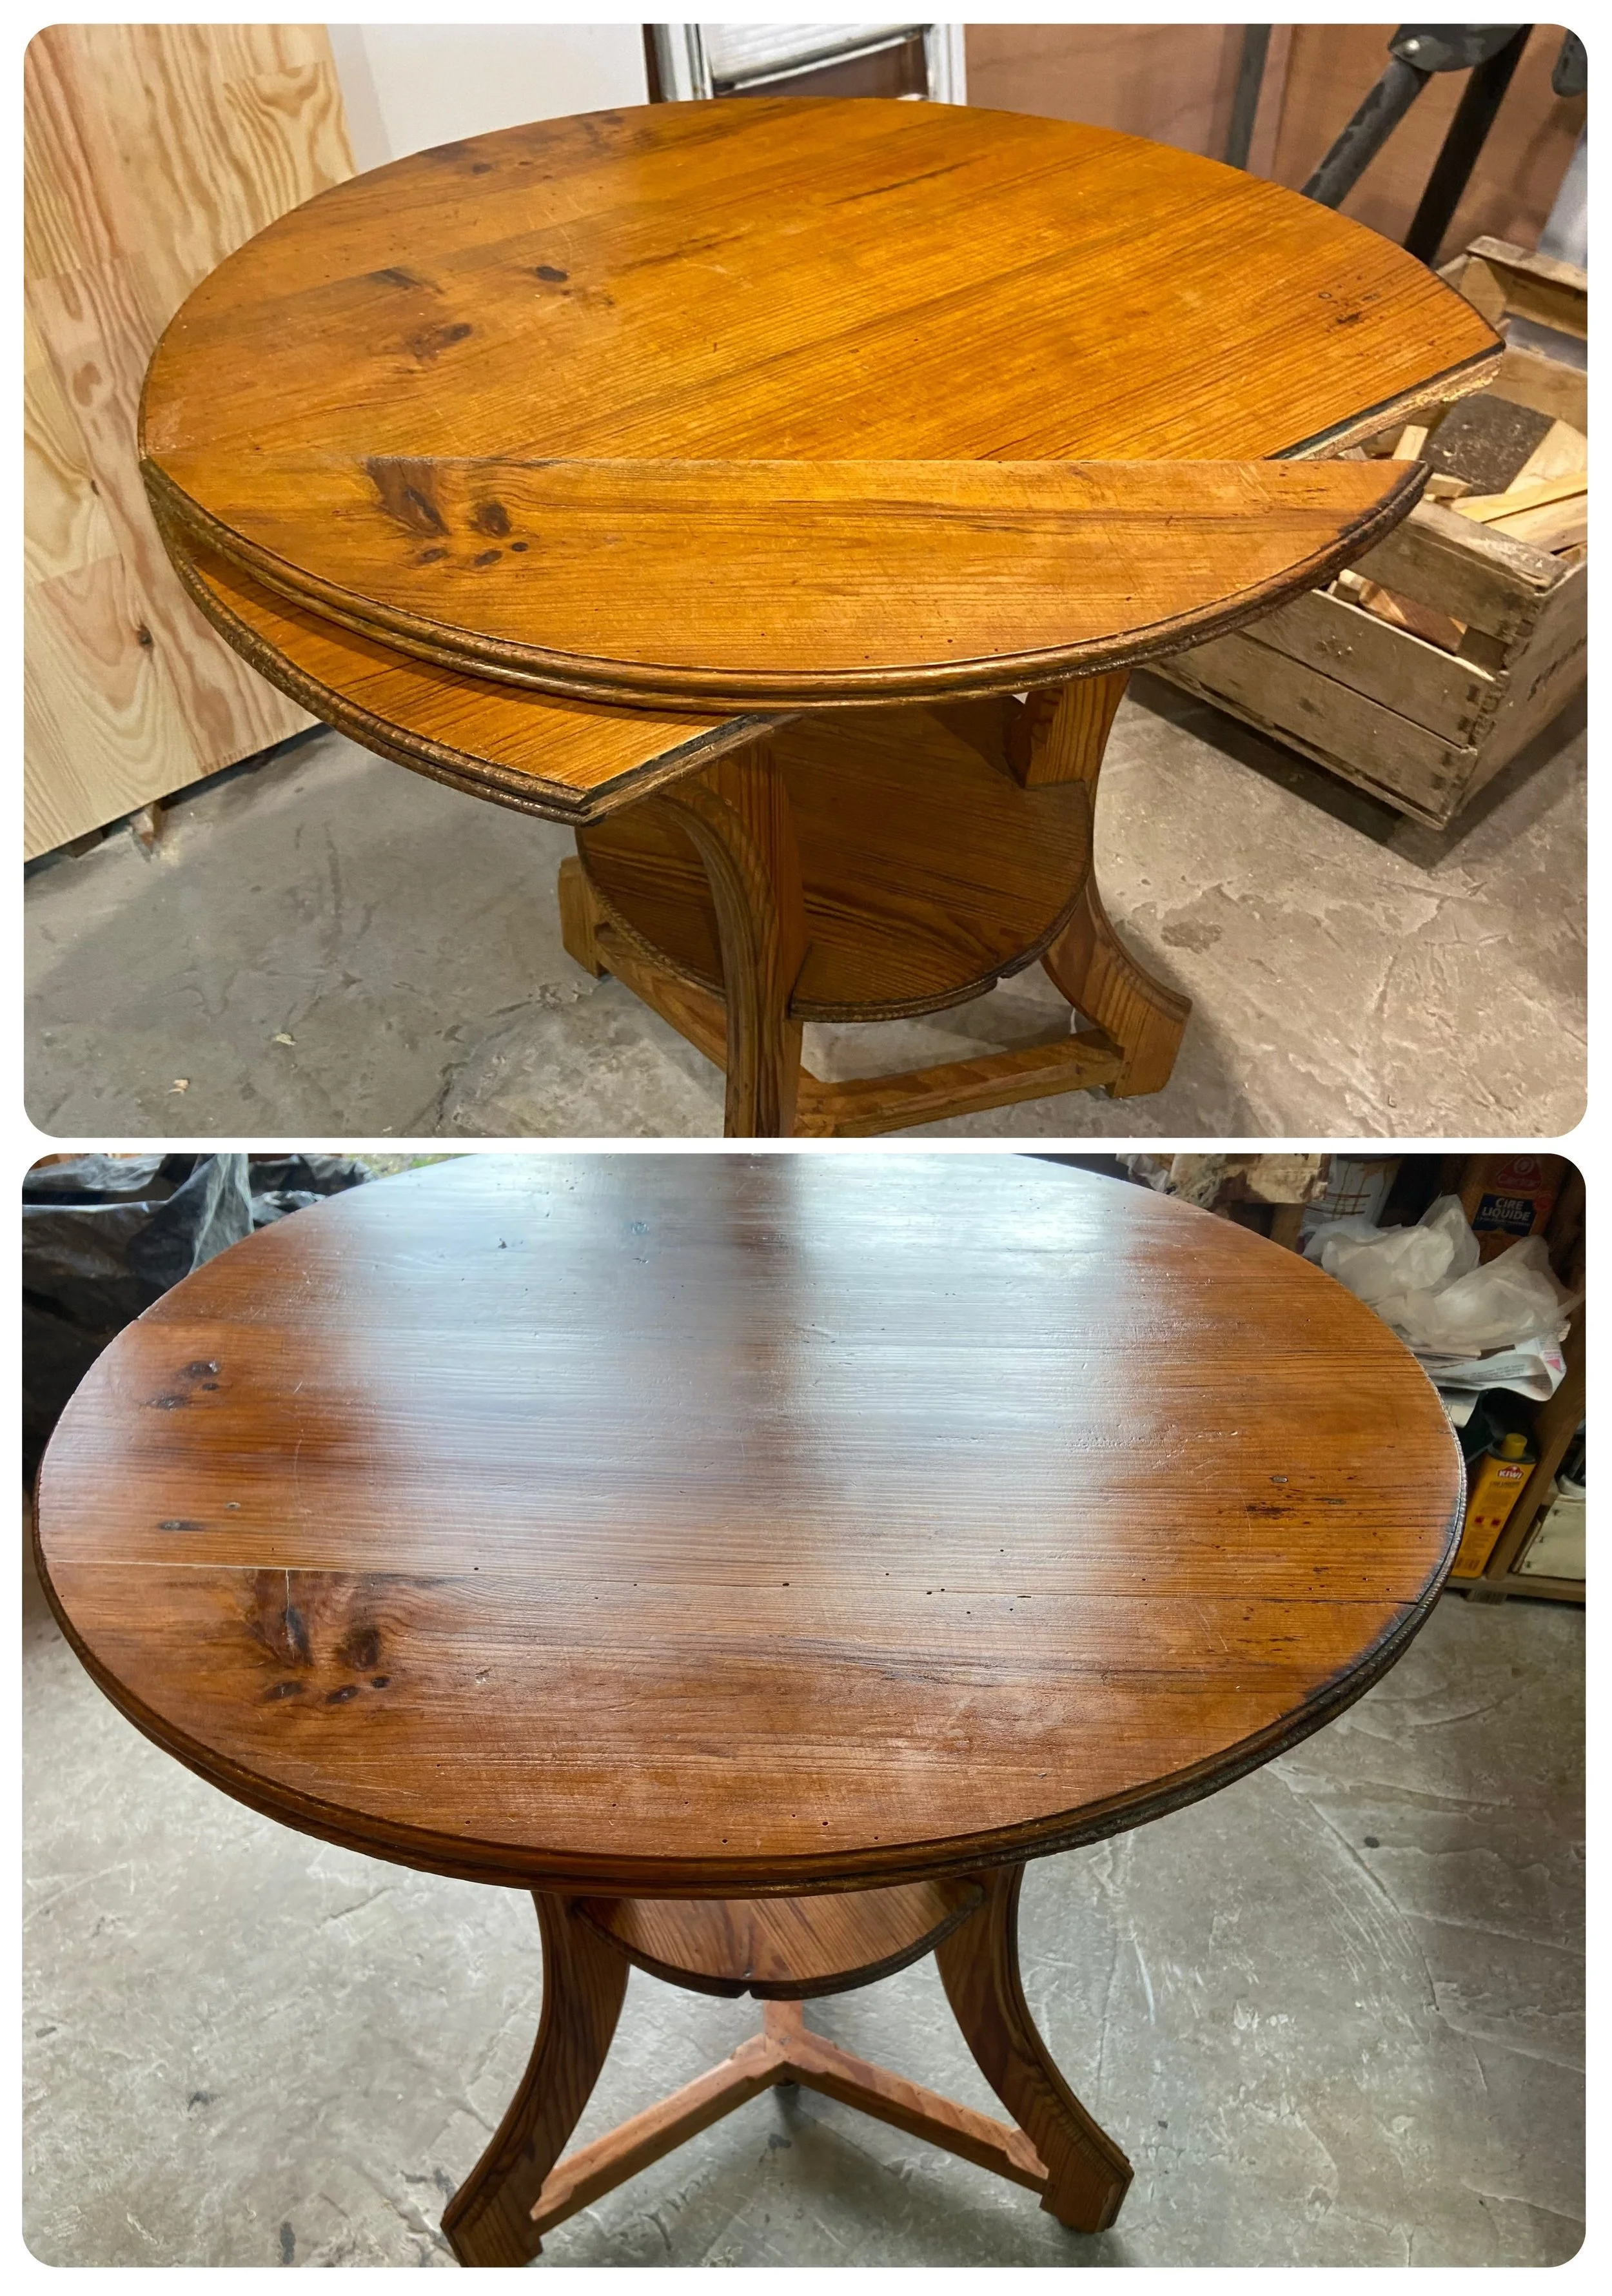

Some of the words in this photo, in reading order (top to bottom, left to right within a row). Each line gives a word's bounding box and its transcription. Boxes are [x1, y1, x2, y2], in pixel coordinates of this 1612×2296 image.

[1495, 1197, 1524, 1210] CIRE
[1482, 1206, 1531, 1221] LIQUIDE
[1499, 1469, 1522, 1480] KIWI
